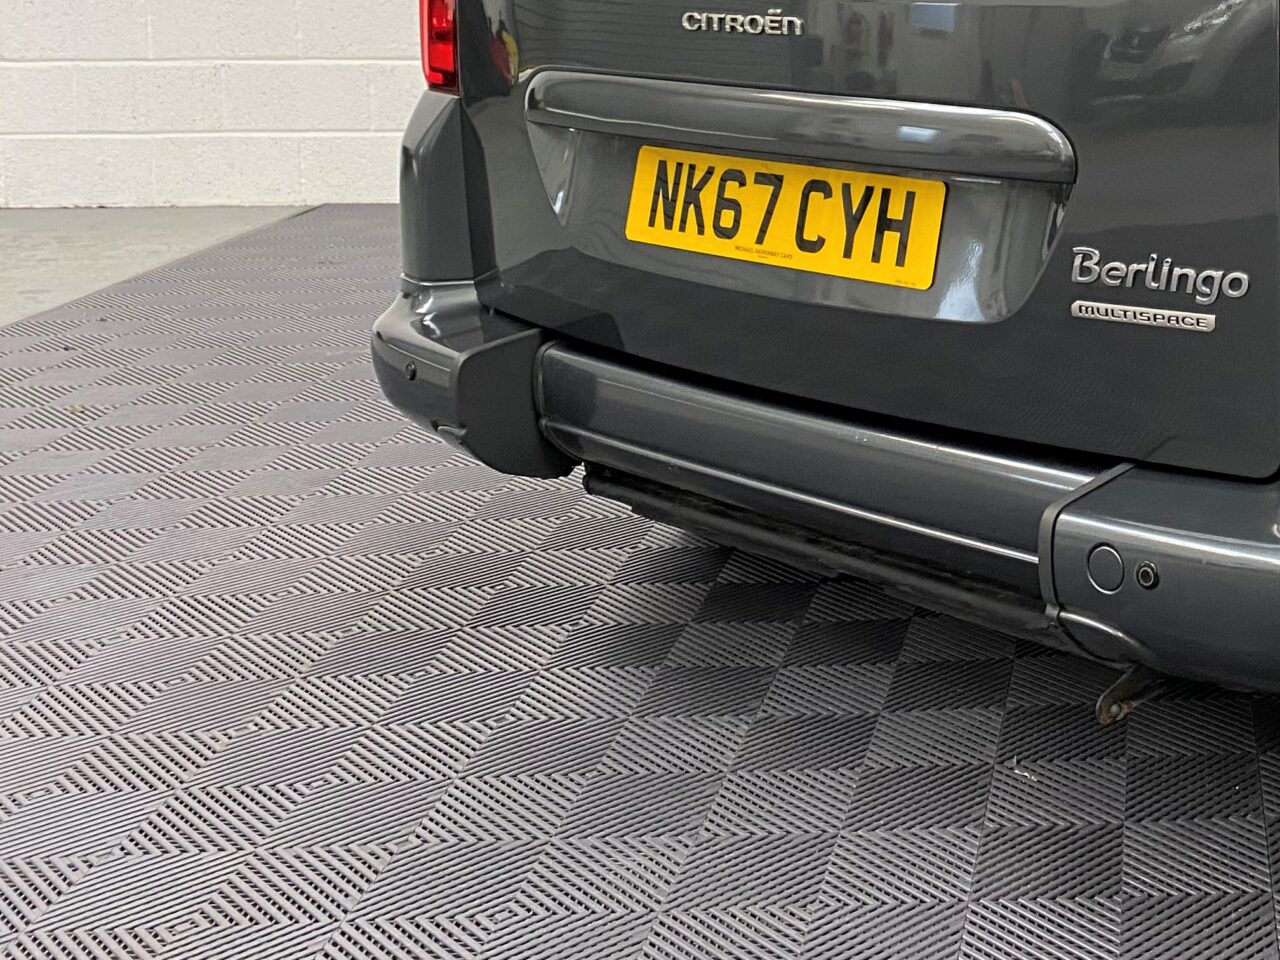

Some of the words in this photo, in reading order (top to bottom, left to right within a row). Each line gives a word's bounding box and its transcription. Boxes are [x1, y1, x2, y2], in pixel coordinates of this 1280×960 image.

[648, 159, 784, 245] NK67
[794, 178, 917, 268] CYH
[1071, 246, 1249, 306] Berlingo
[1078, 304, 1209, 329] MULTISPACE
